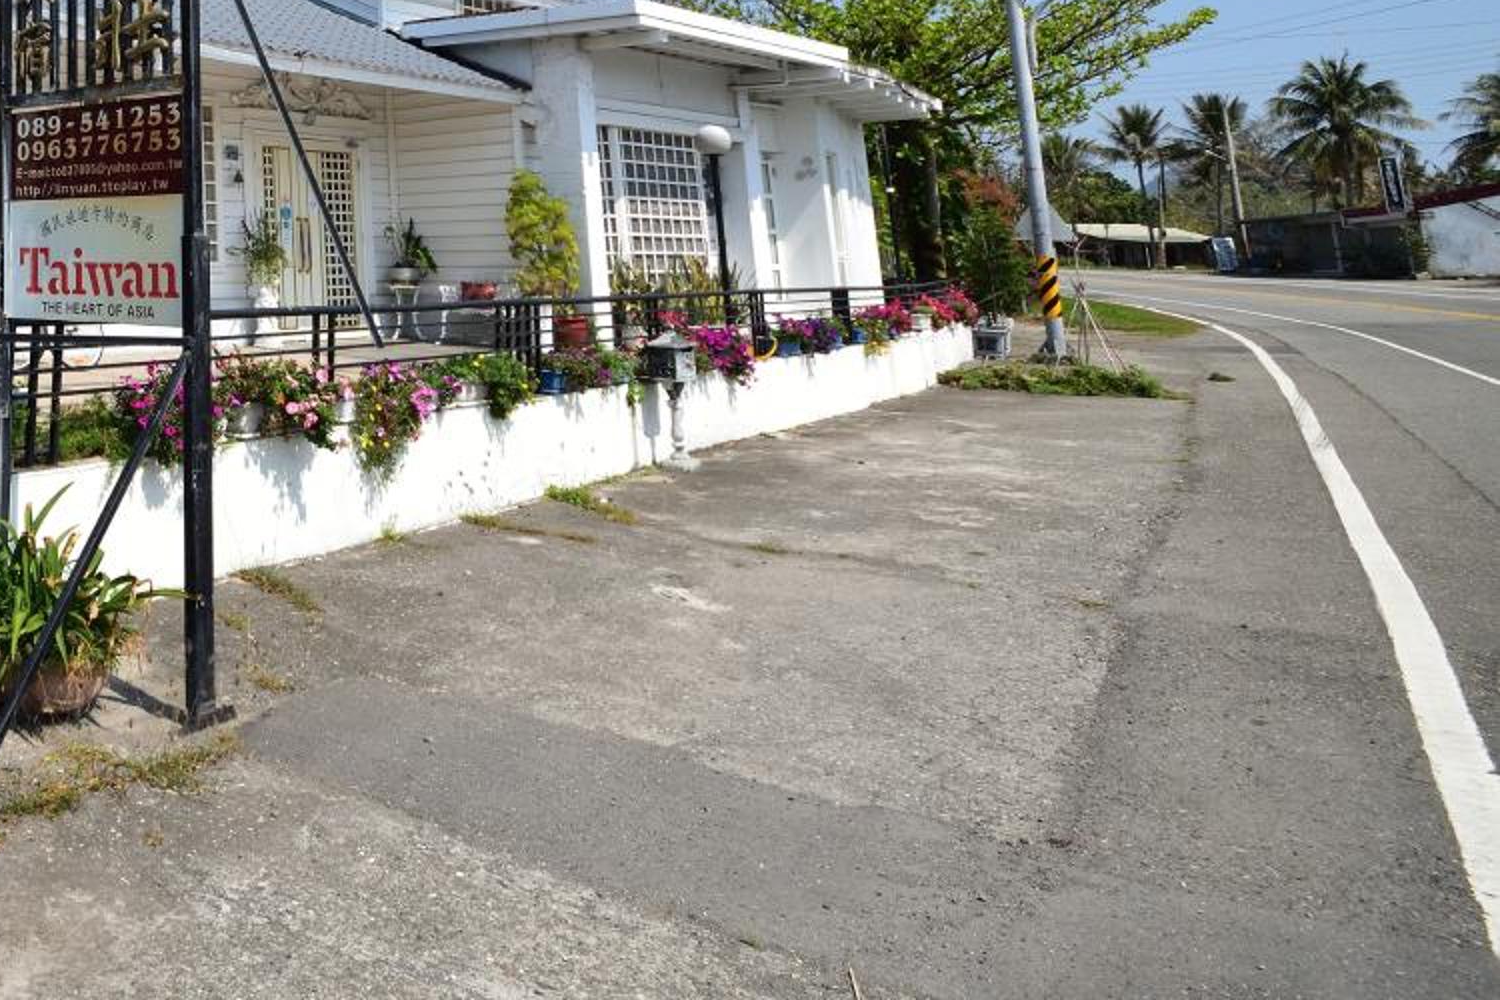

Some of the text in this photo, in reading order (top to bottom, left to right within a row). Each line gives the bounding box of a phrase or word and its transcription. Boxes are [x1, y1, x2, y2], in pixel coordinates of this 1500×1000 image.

[17, 102, 181, 139] 089-541253
[17, 128, 181, 161] 0963776753
[20, 247, 180, 299] Taiwan
[43, 302, 155, 318] THE HEART OF ASIA
